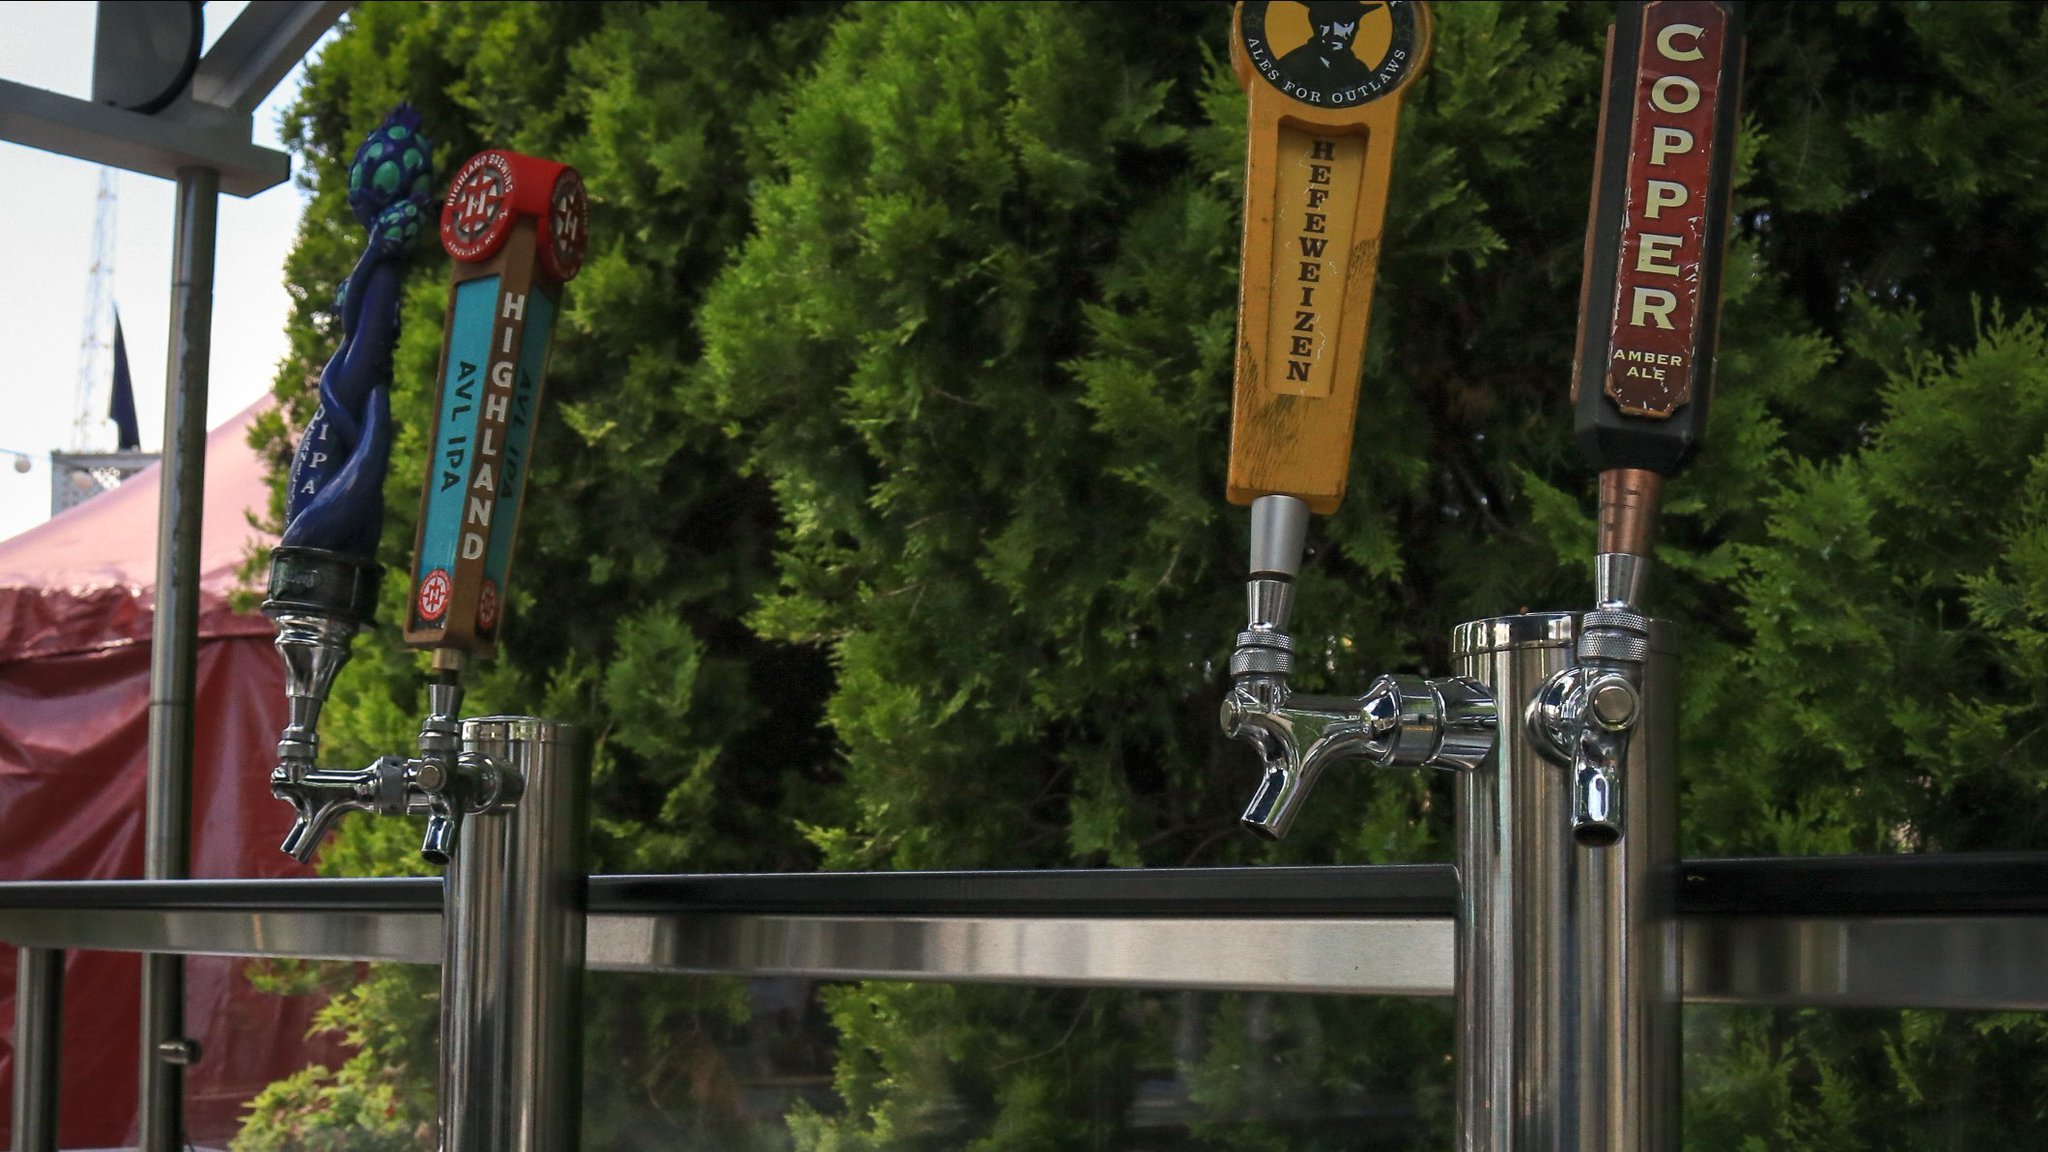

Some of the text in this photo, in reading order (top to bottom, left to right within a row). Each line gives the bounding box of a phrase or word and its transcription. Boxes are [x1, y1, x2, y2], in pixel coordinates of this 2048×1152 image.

[1248, 37, 1406, 104] ALES FOR OUTLAWS
[447, 155, 487, 207] HIGHLAND
[488, 153, 514, 193] BREWING
[1629, 22, 1705, 331] COPPER
[1286, 139, 1336, 382] HEFEWEIZEN
[1613, 349, 1683, 367] AMBER
[1626, 366, 1666, 381] ALE
[440, 360, 477, 492] AVL IPA
[461, 291, 526, 560] HIGHLAND
